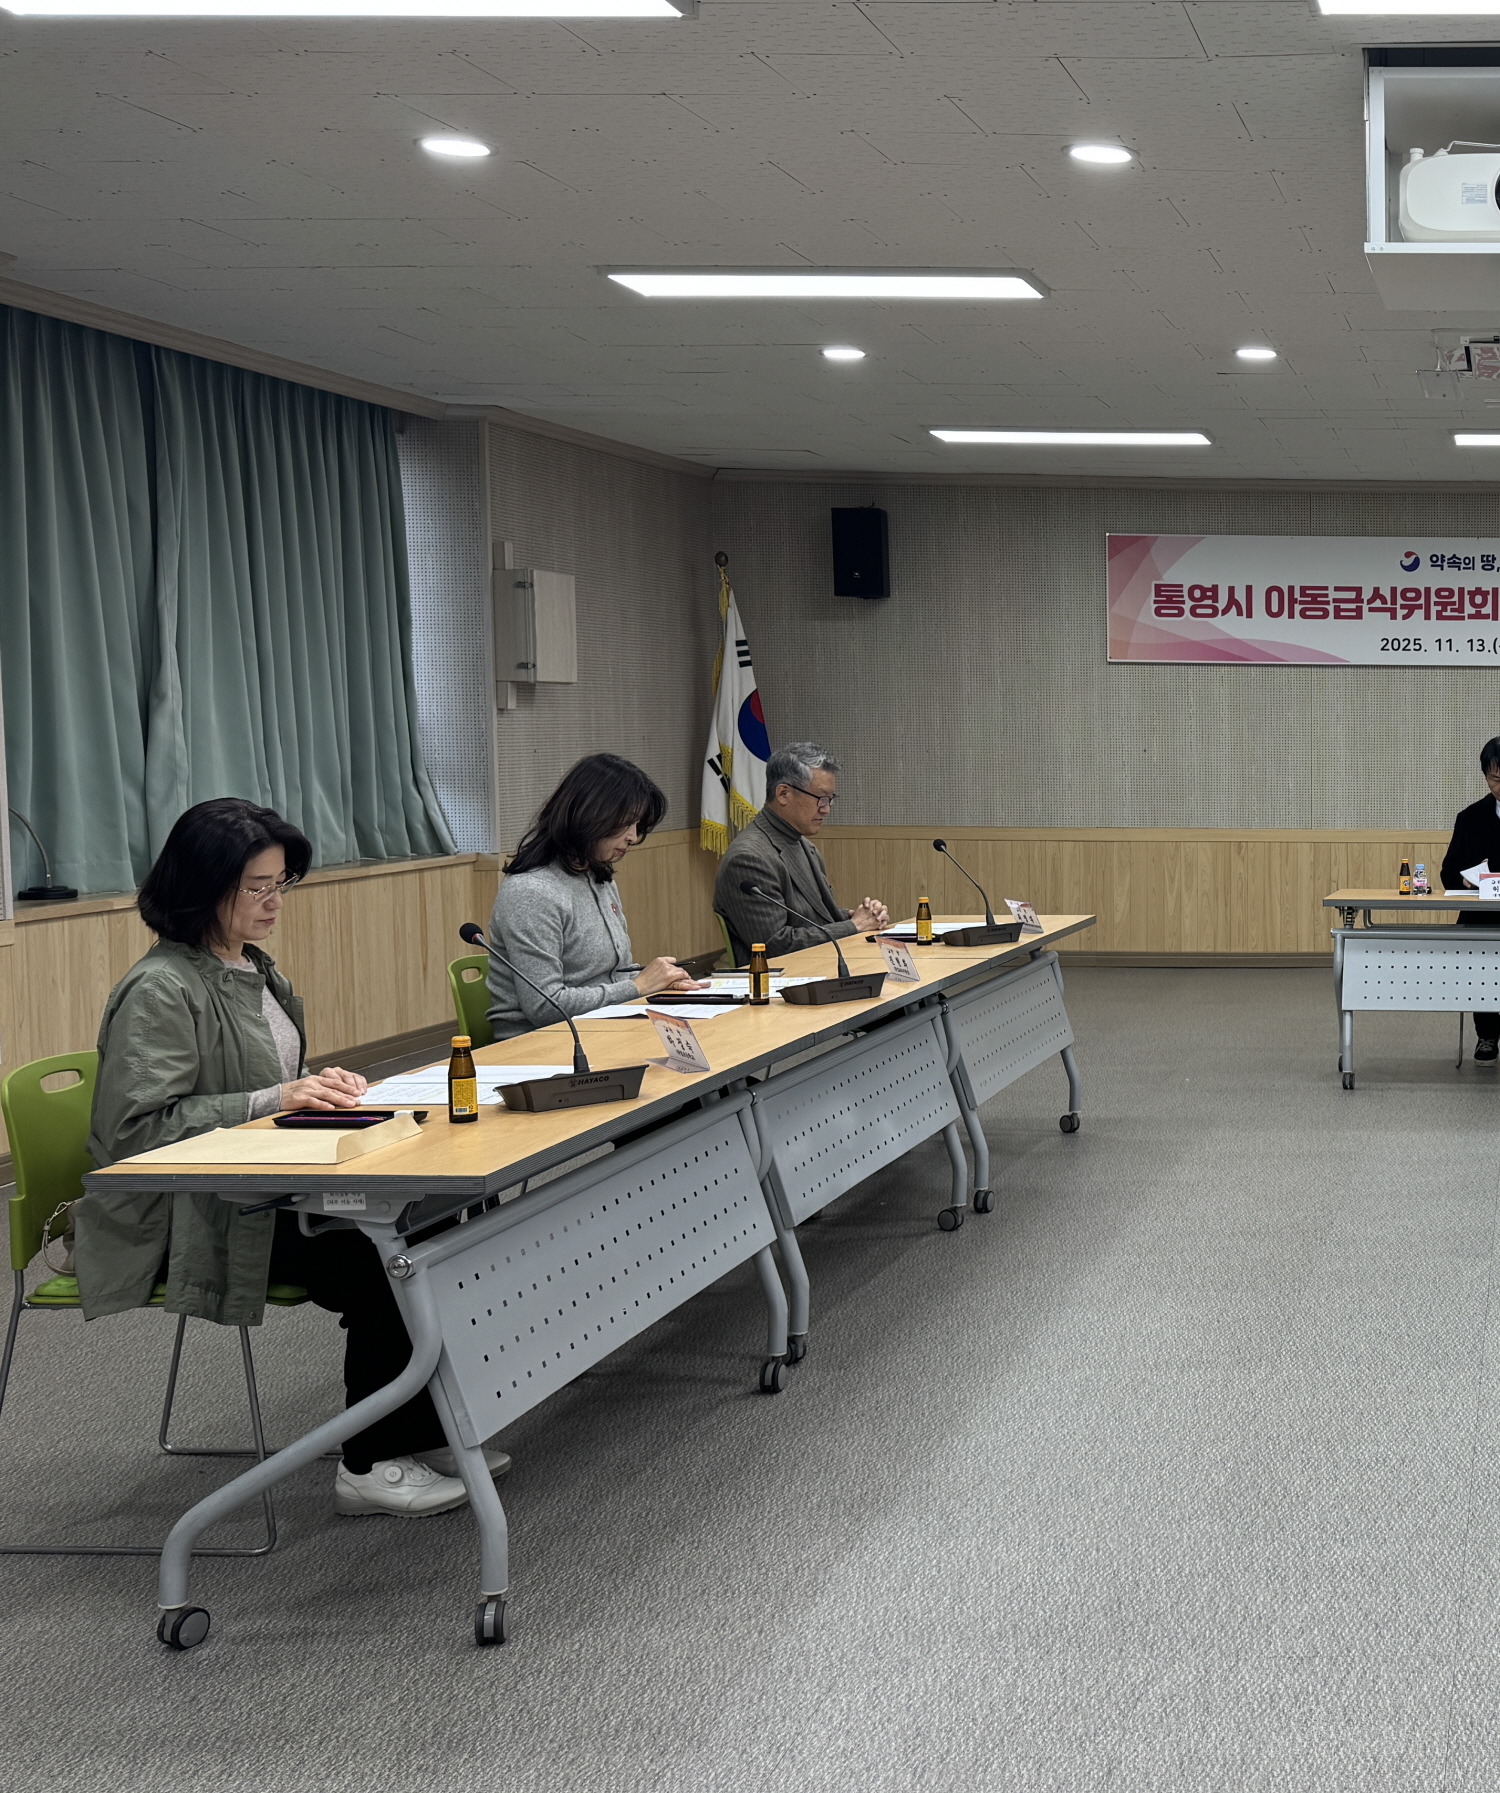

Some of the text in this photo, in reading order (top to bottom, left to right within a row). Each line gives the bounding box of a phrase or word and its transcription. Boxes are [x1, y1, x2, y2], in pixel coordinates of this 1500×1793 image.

[1429, 553, 1476, 571] 약속의
[1480, 553, 1500, 572] 땅,
[1152, 583, 1253, 619] 통영시
[1264, 584, 1499, 621] 아동급식위원회
[1380, 637, 1428, 652] 2025.
[1435, 638, 1459, 652] 11.
